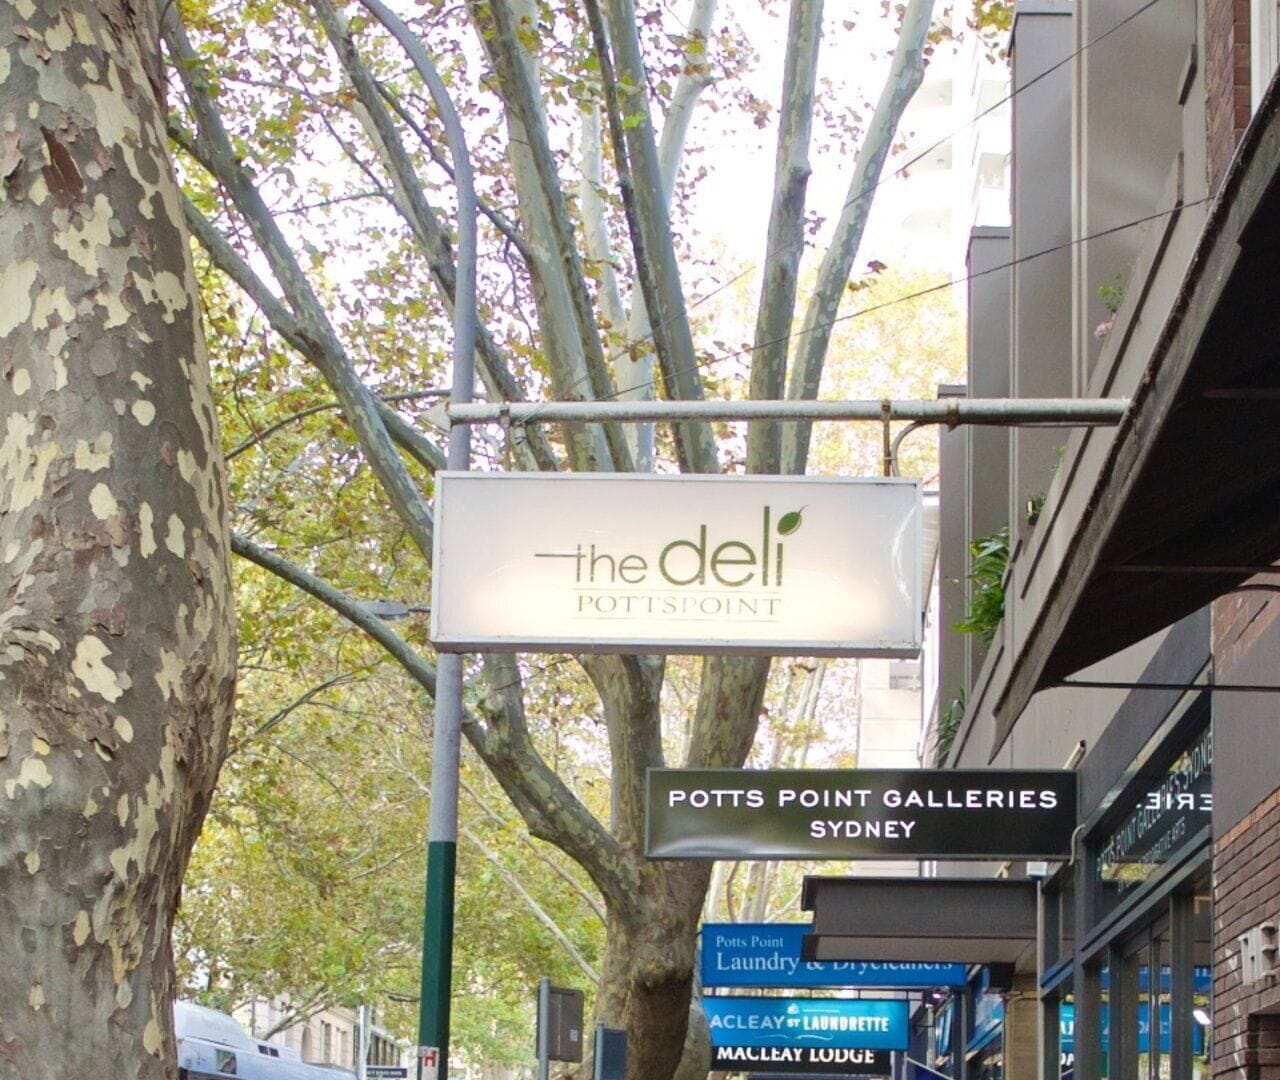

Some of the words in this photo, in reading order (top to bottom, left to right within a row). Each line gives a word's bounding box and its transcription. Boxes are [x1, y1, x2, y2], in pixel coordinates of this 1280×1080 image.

[535, 543, 648, 584] the
[658, 505, 808, 587] deli
[668, 789, 764, 808] POTTS
[778, 789, 871, 808] POINT
[883, 789, 1058, 809] GALLERIES
[809, 820, 916, 839] SYDNEY
[715, 935, 747, 948] Potts
[751, 935, 784, 948] Point
[716, 952, 800, 975] Laundry
[709, 1014, 785, 1030] ACLEAY
[786, 1018, 801, 1028] ST
[803, 1016, 889, 1032] LAUNDRETTE
[716, 1047, 804, 1062] MACLEAY
[809, 1049, 876, 1064] LODGE
